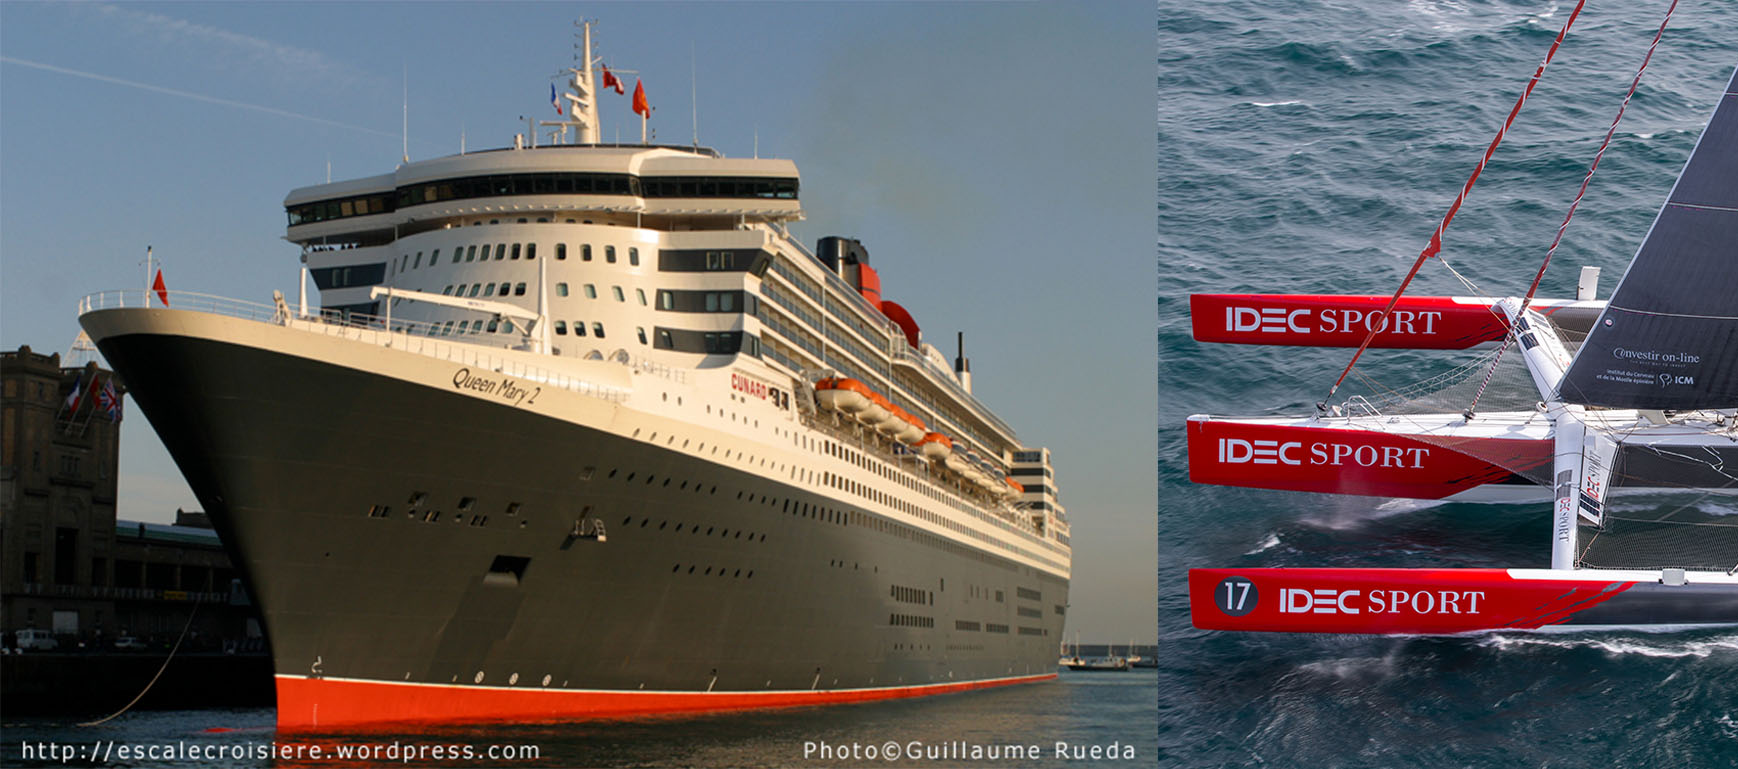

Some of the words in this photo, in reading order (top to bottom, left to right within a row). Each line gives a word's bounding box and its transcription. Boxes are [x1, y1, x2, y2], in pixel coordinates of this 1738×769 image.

[1226, 306, 1311, 334] IDEC
[1319, 309, 1442, 335] SPORT
[1662, 352, 1700, 364] on-line
[452, 368, 496, 393] Queen
[495, 379, 529, 407] Mary
[527, 387, 541, 404] 2
[731, 373, 767, 400] CUNARD
[1675, 376, 1694, 385] ICM
[1219, 438, 1302, 466] IDEC
[1310, 442, 1430, 469] SPORT
[1224, 582, 1251, 610] 17
[1279, 588, 1361, 614] IDEC
[1368, 589, 1486, 615] SPORT
